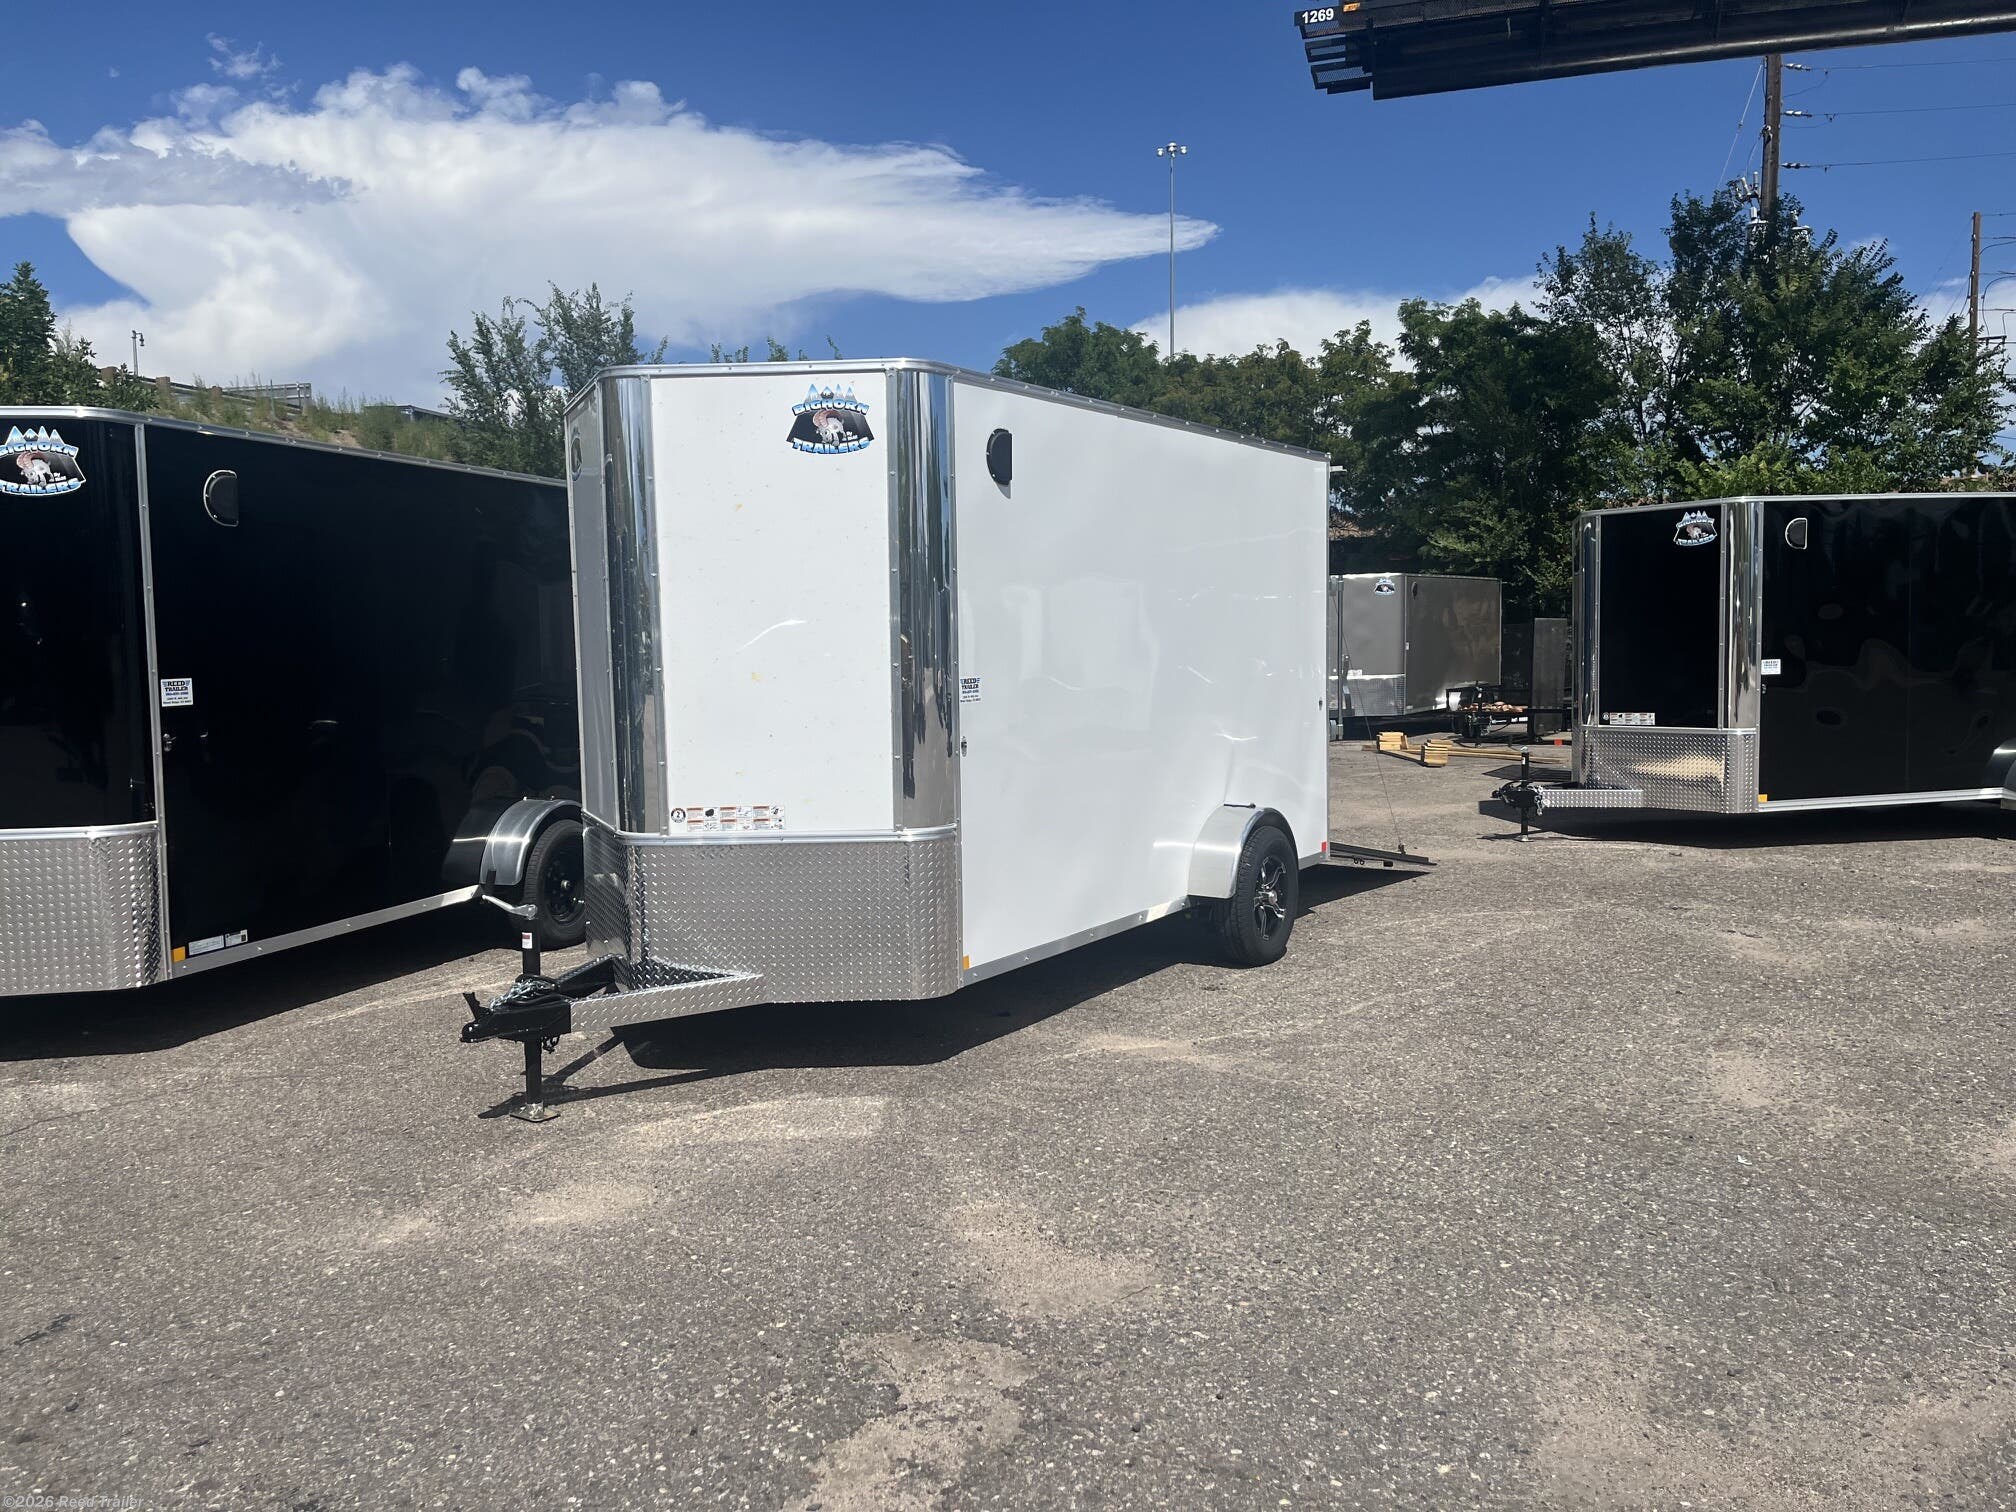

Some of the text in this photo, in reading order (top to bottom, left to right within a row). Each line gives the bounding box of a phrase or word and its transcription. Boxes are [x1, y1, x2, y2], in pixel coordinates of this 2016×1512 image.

[1302, 7, 1334, 24] 1269
[792, 399, 870, 416] BIGHORN
[792, 437, 870, 454] TRAILERS
